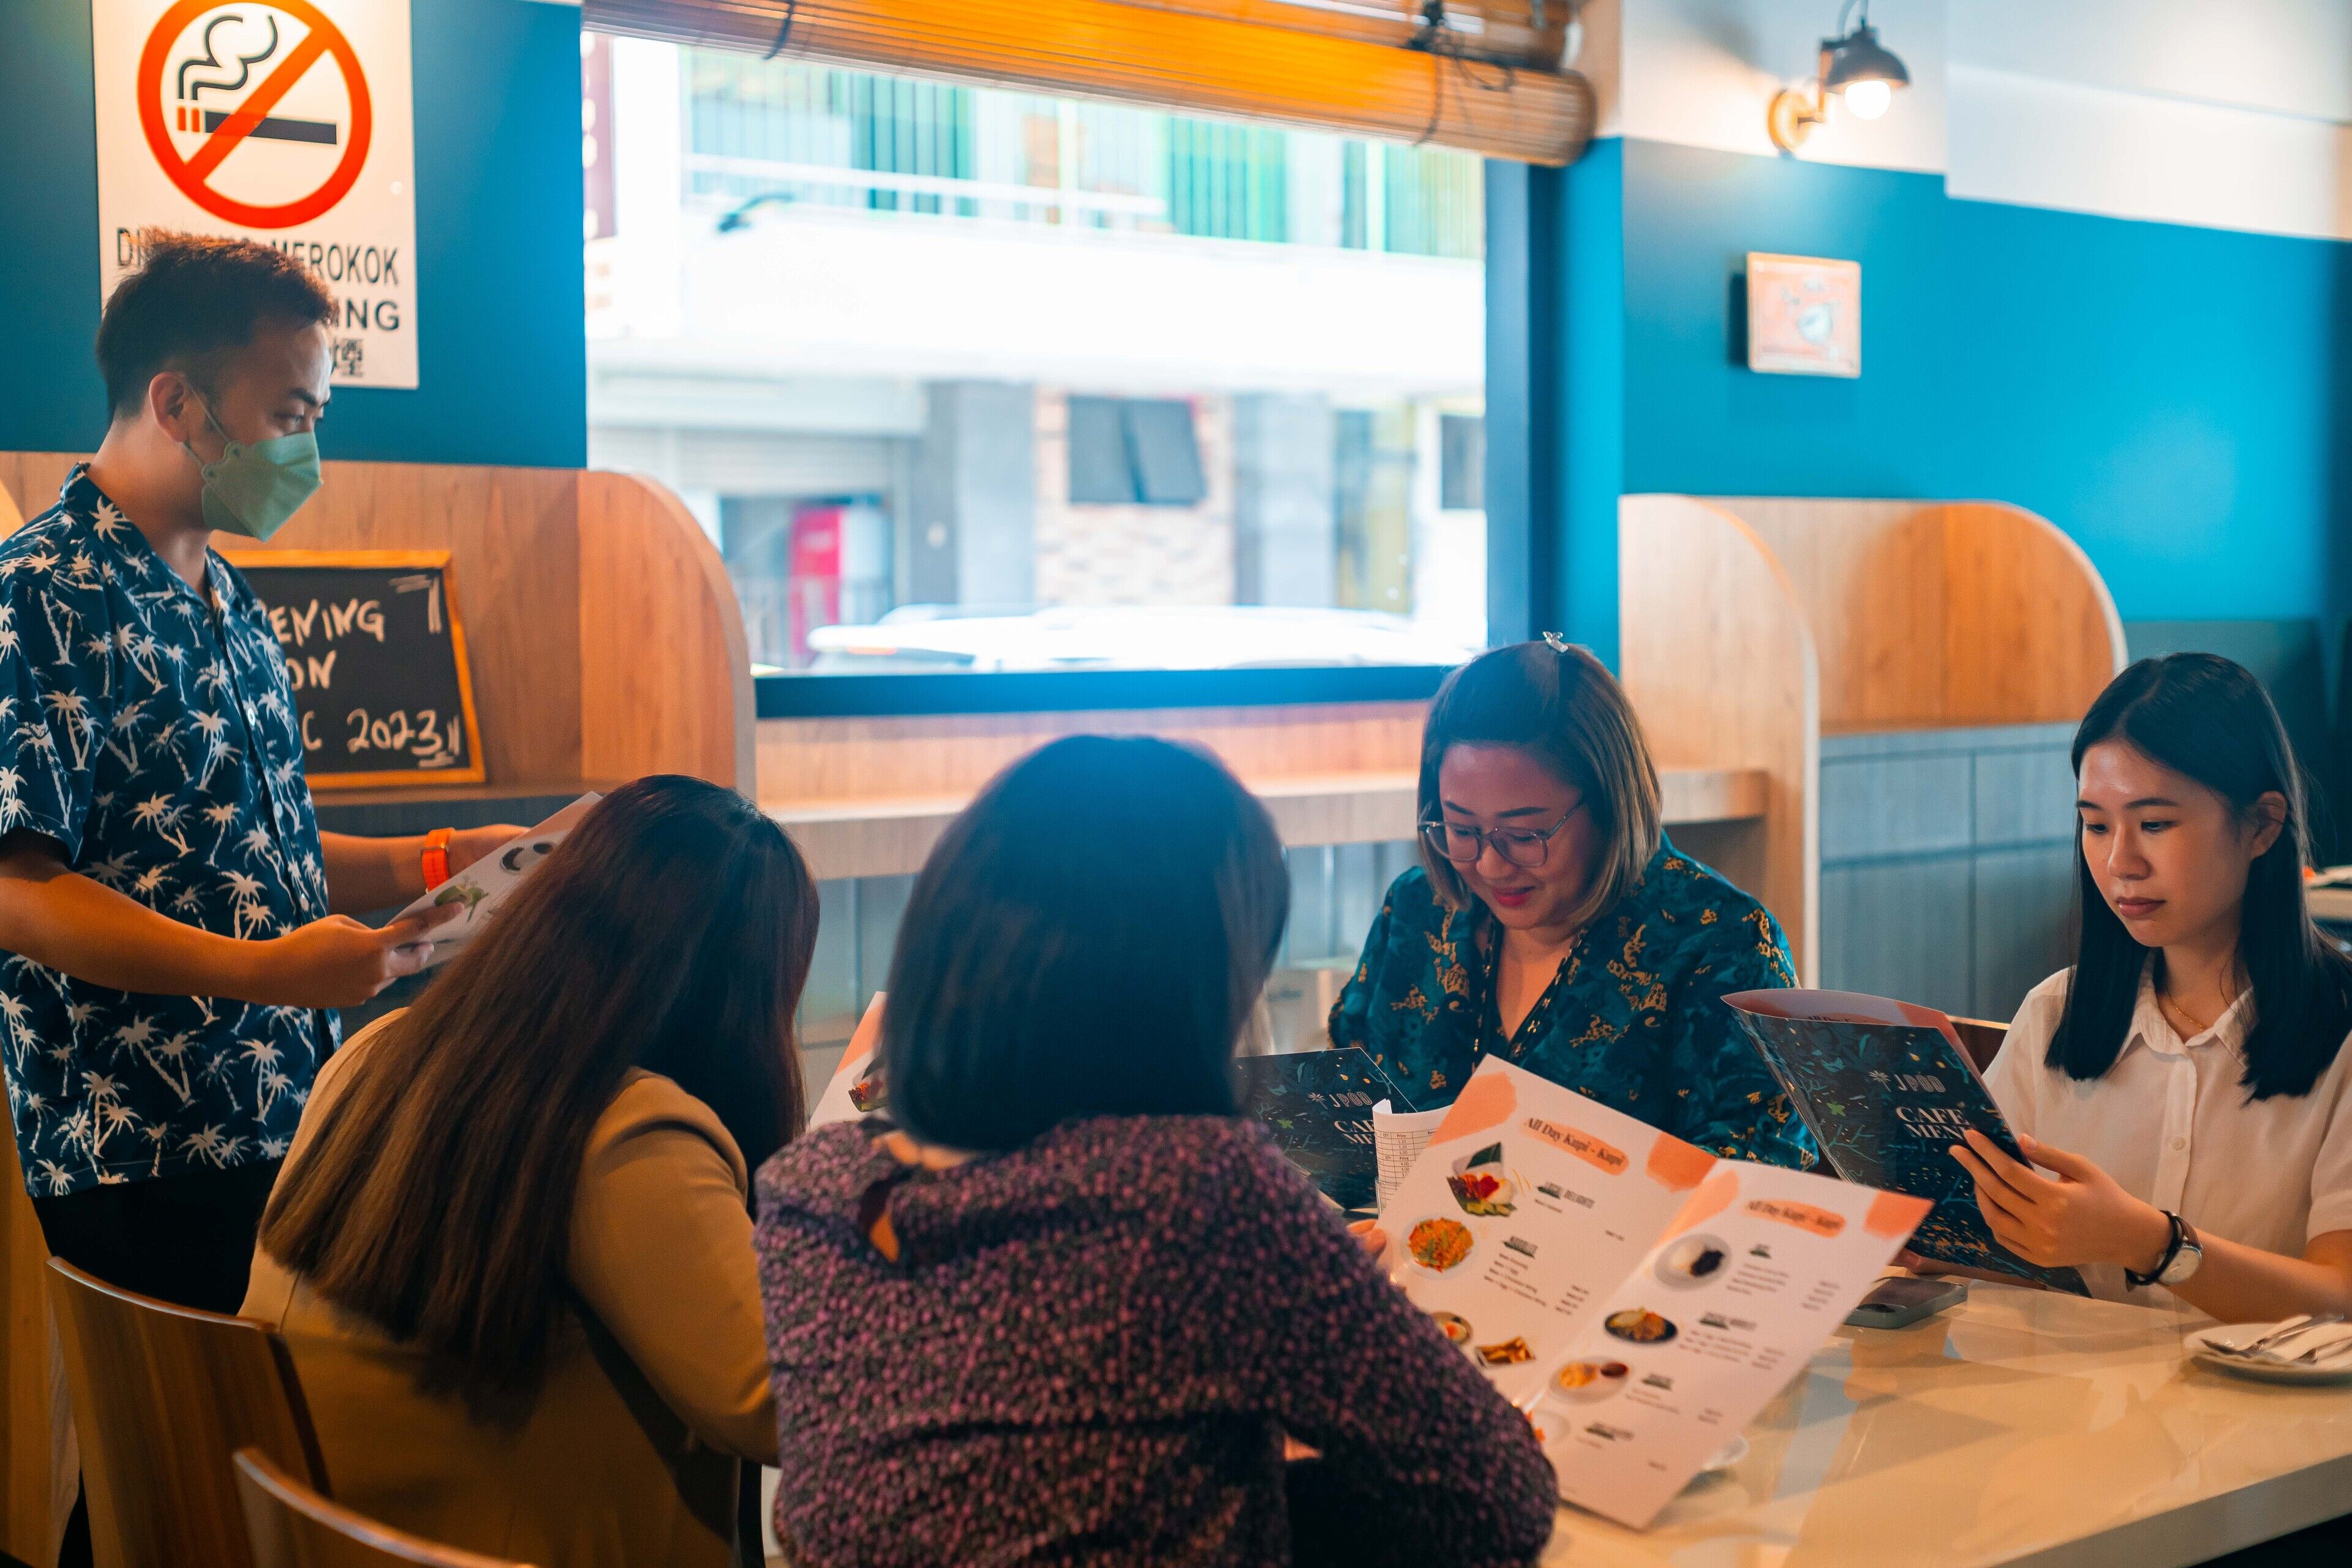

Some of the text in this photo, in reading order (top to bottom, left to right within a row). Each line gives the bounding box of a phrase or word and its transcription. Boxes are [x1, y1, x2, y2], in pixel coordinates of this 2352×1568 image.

[260, 598, 386, 647] ENING
[346, 707, 443, 756] 2023
[1896, 1107, 1970, 1125] CAFE
